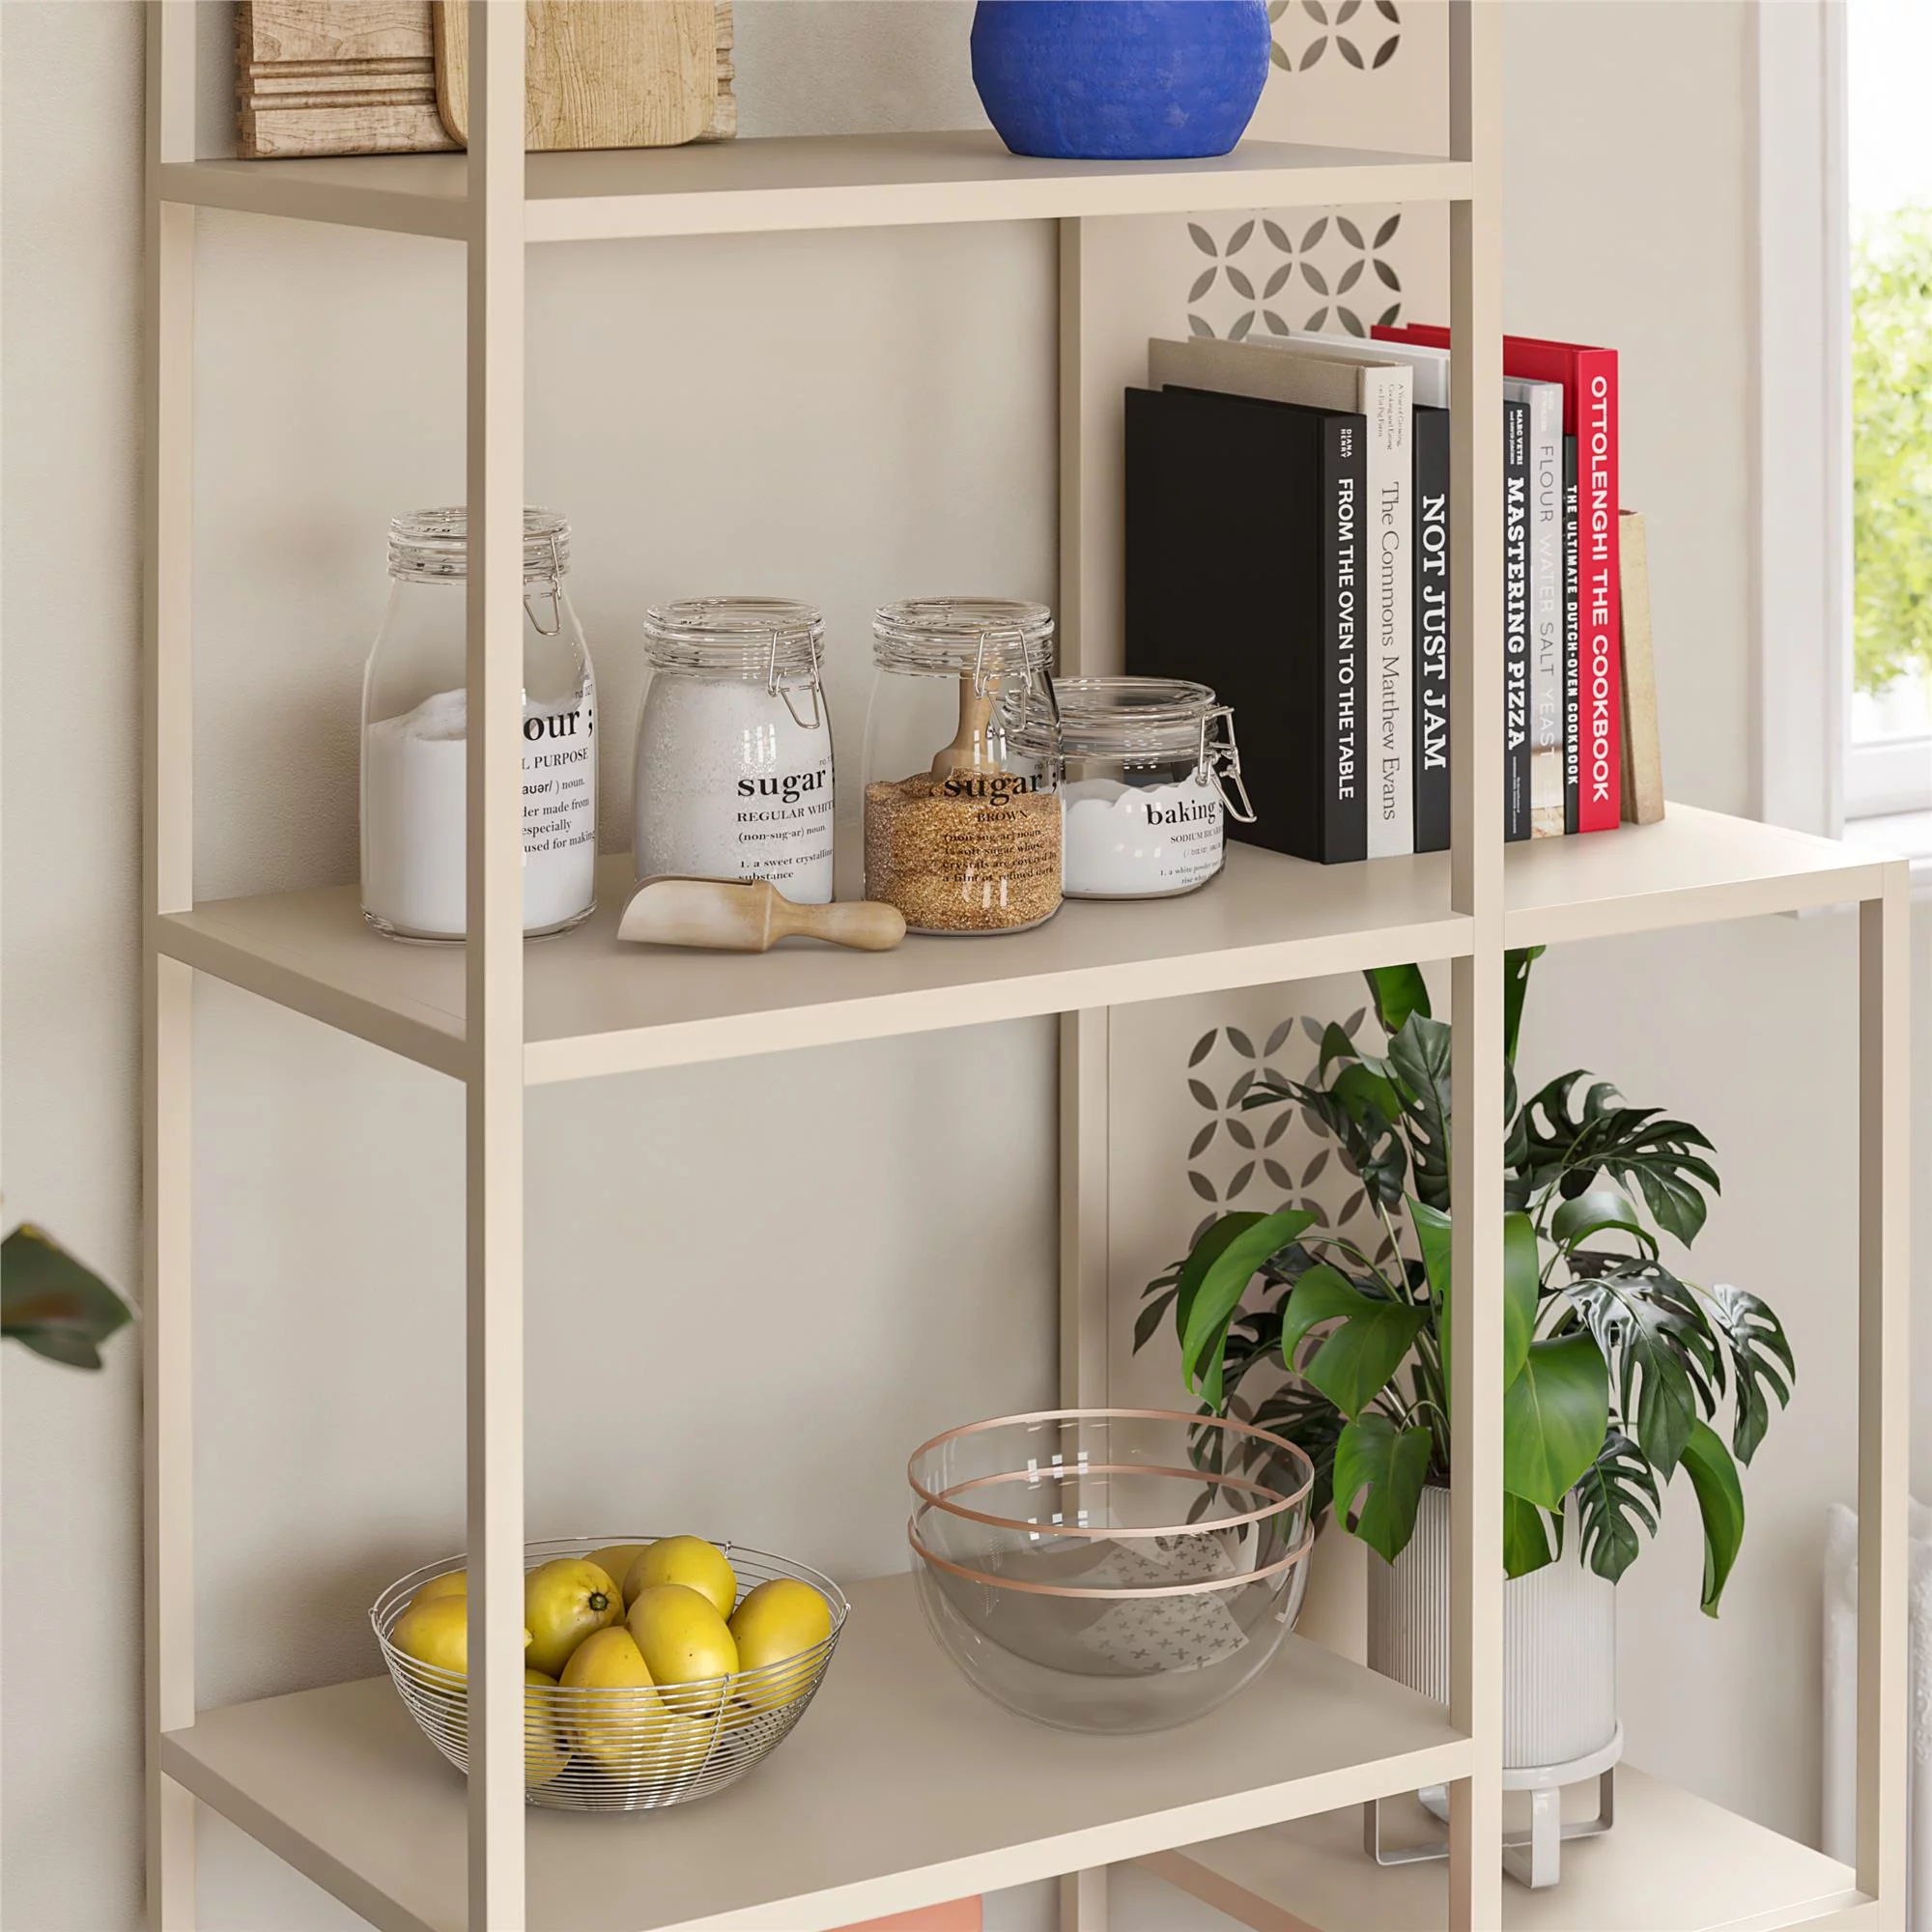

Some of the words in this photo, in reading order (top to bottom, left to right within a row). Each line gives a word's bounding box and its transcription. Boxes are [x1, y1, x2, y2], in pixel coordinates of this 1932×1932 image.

[1539, 445, 1554, 523] FLOUR
[1591, 375, 1608, 562] OTTOLENGHI
[1338, 478, 1354, 542] FROM
[1381, 480, 1400, 526] The
[1566, 485, 1577, 515] THE
[1423, 494, 1446, 577] NOT
[1566, 520, 1577, 594] ULTIMATE
[1338, 544, 1354, 588] THE
[1507, 476, 1524, 654] MASTERING
[1539, 534, 1554, 612] WATER
[1381, 530, 1400, 647] Commons
[1592, 568, 1608, 626] THE
[1338, 590, 1354, 650] OVEN
[1423, 585, 1446, 680] JUST
[1338, 654, 1354, 684] TO
[1539, 622, 1554, 676] SALT
[523, 709, 580, 741] our
[1338, 687, 1354, 730] THE
[1382, 656, 1400, 750] Matthew
[1507, 660, 1525, 751] PIZZA
[1539, 688, 1554, 760] YEAST
[1592, 635, 1609, 803] COOKBOOK
[1423, 689, 1447, 771] JAM
[1567, 702, 1578, 784] COOKBOOK
[533, 747, 589, 769] PURPOSE
[1338, 736, 1354, 800] TABLE
[543, 802, 570, 815] made
[571, 797, 590, 811] from
[737, 769, 826, 804] sugar
[943, 772, 1043, 807] sugar
[1382, 757, 1401, 821] Evans
[522, 818, 573, 838] especially
[737, 807, 805, 822] REGULAR
[738, 825, 805, 843] (non-sug-ar)
[977, 810, 1028, 822] BROWN
[1145, 799, 1216, 826] baking
[524, 840, 550, 853] used
[553, 838, 568, 850] for
[942, 859, 989, 869] crystals
[1012, 852, 1047, 867] covered
[984, 846, 1014, 857] sugar
[1017, 841, 1044, 852] whose
[1170, 832, 1204, 844] SODIUM
[738, 871, 795, 881] substance
[763, 858, 793, 867] sweet
[1175, 865, 1193, 875] white
